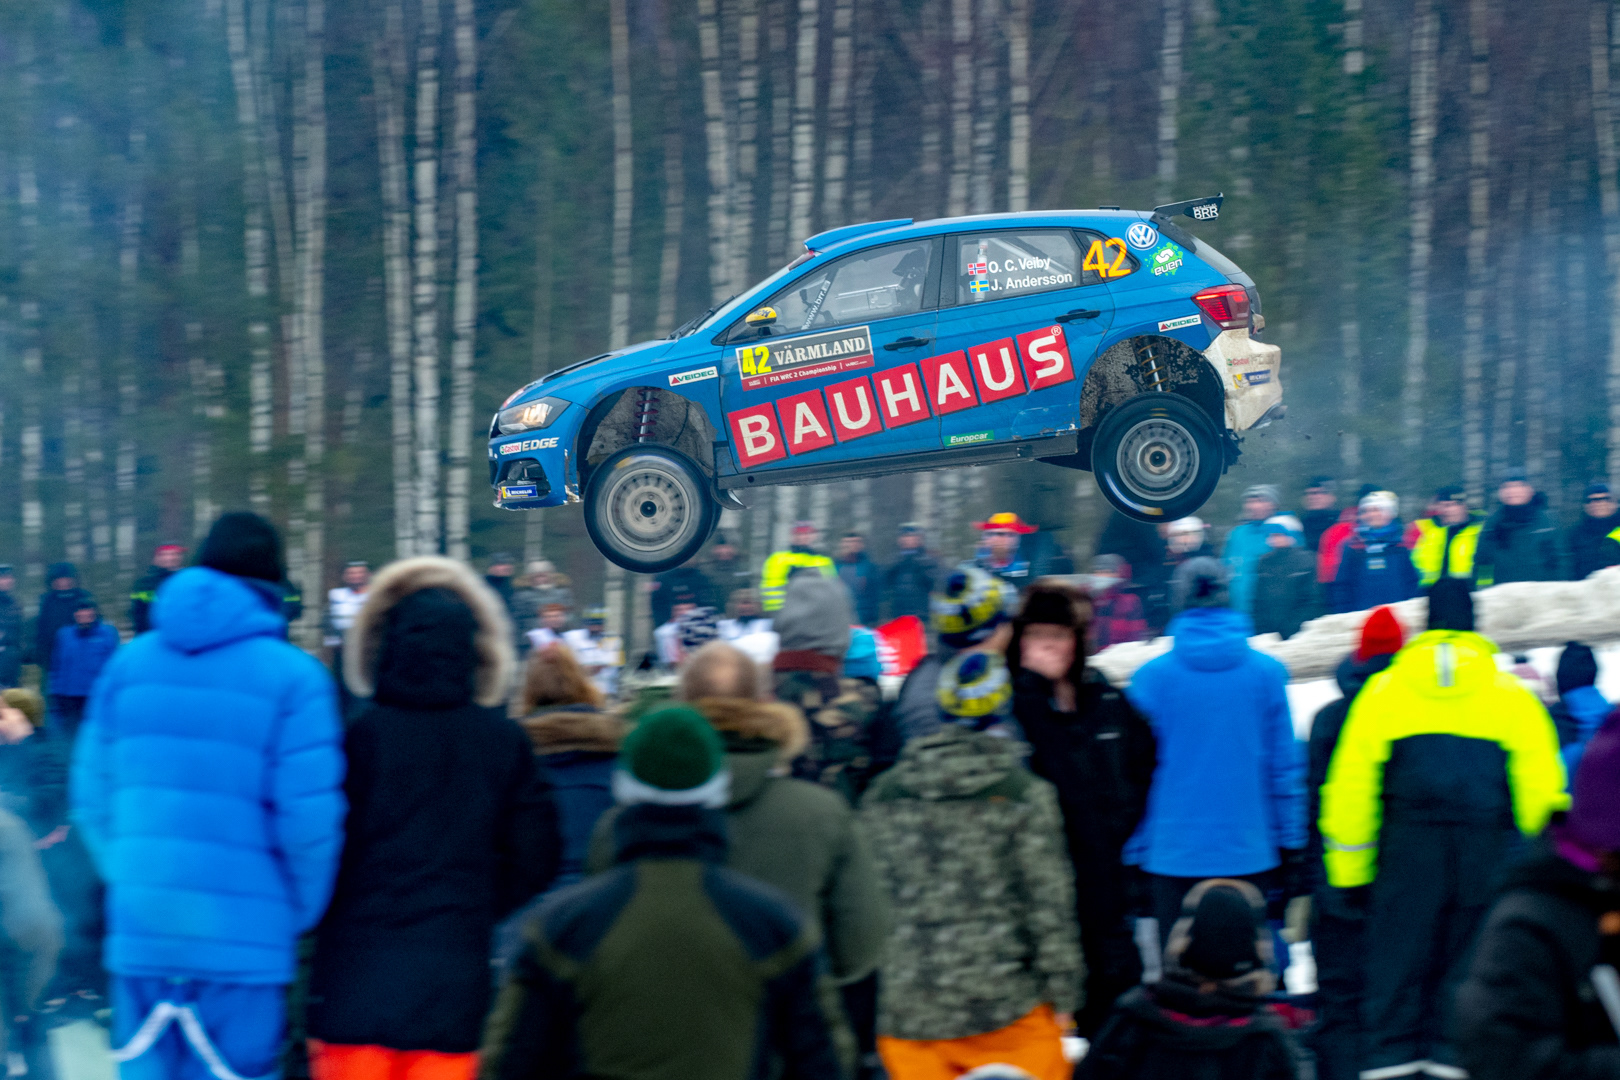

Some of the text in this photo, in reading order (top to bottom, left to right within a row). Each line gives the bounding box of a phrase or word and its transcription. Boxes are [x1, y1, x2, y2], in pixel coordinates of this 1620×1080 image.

[1194, 206, 1219, 220] BRR
[988, 256, 1051, 274] O. C. Veiby
[1083, 237, 1131, 278] 42
[991, 273, 1073, 291] J. Andersson
[1166, 317, 1199, 329] VEIDEC
[742, 337, 866, 376] 42 VÄRMLAND
[678, 369, 715, 382] VEIDEC
[799, 365, 837, 377] Championship
[738, 335, 1064, 458] BAUHAUS
[522, 437, 560, 452] EDGE
[951, 433, 989, 443] Europcar
